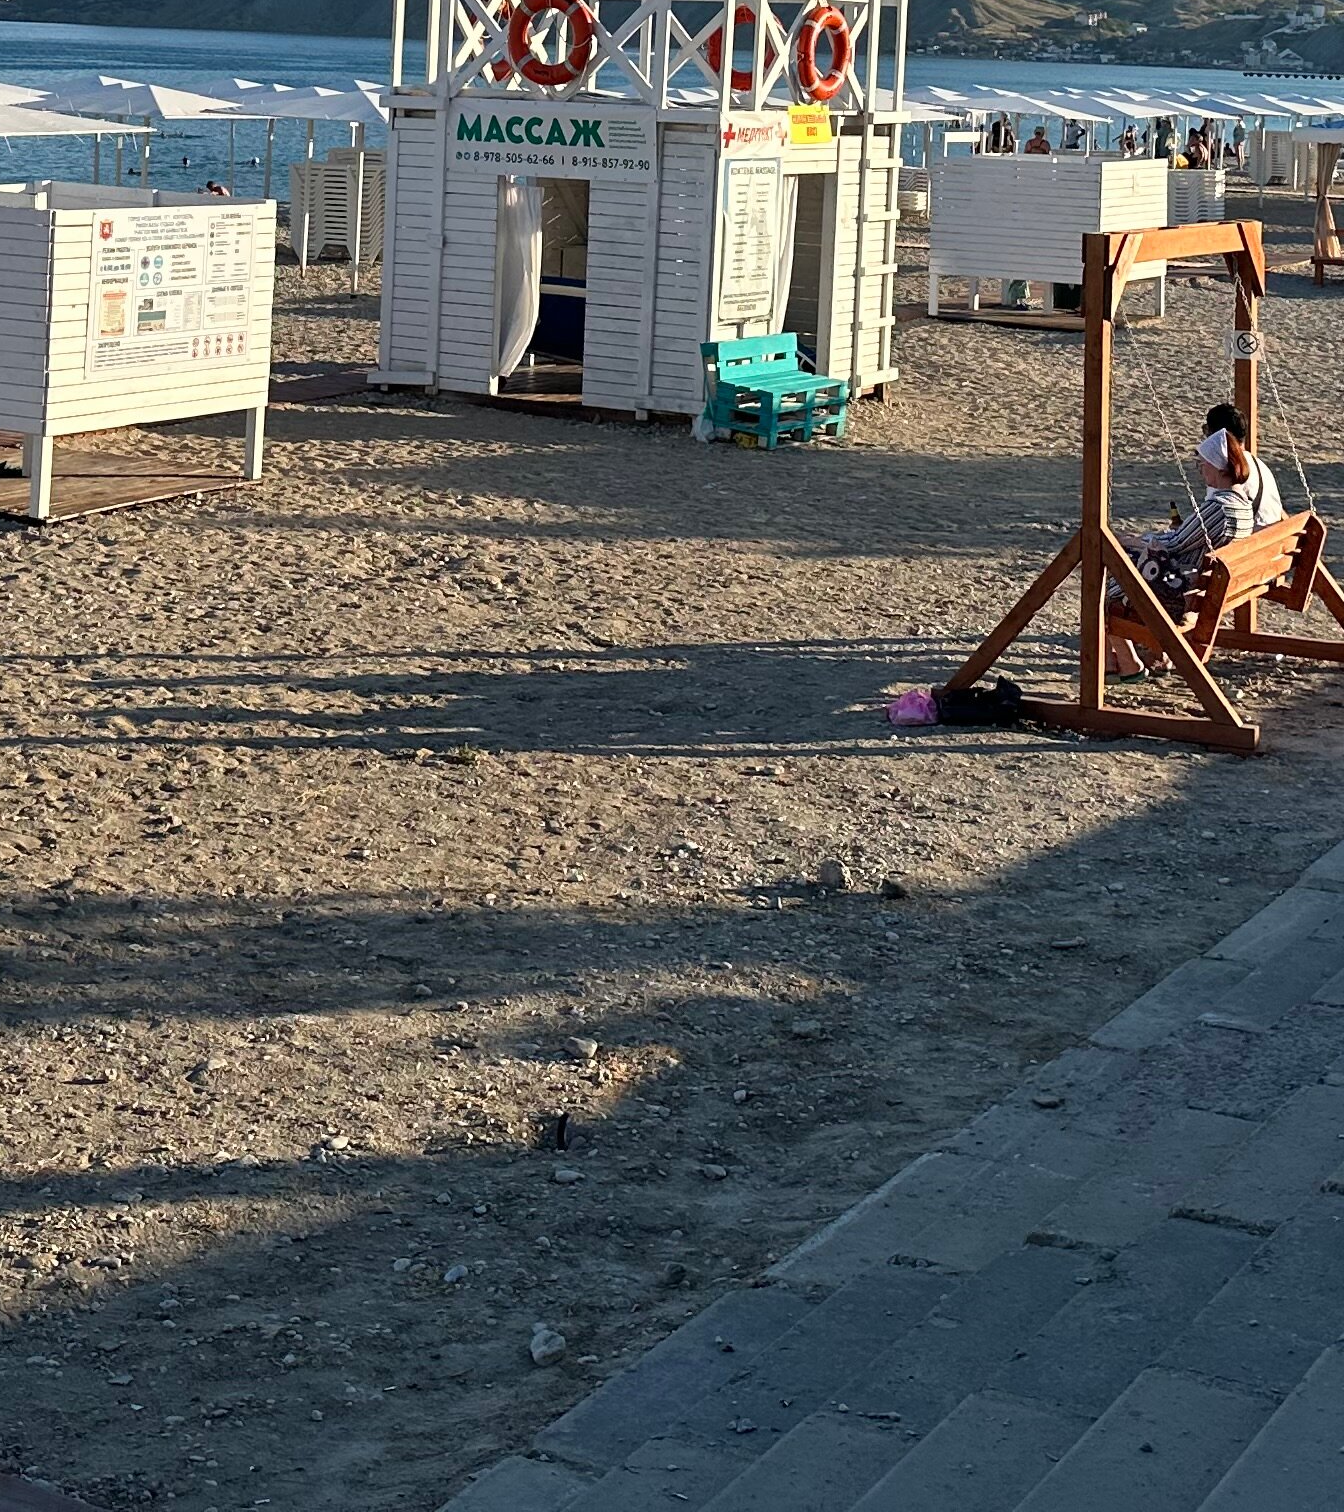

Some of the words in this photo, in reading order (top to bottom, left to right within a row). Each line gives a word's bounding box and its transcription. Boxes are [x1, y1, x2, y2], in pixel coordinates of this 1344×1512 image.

[457, 113, 605, 148] МАССАЖ
[473, 151, 555, 165] 8-978-505-62-66
[571, 155, 651, 171] 8-915-857-92-90
